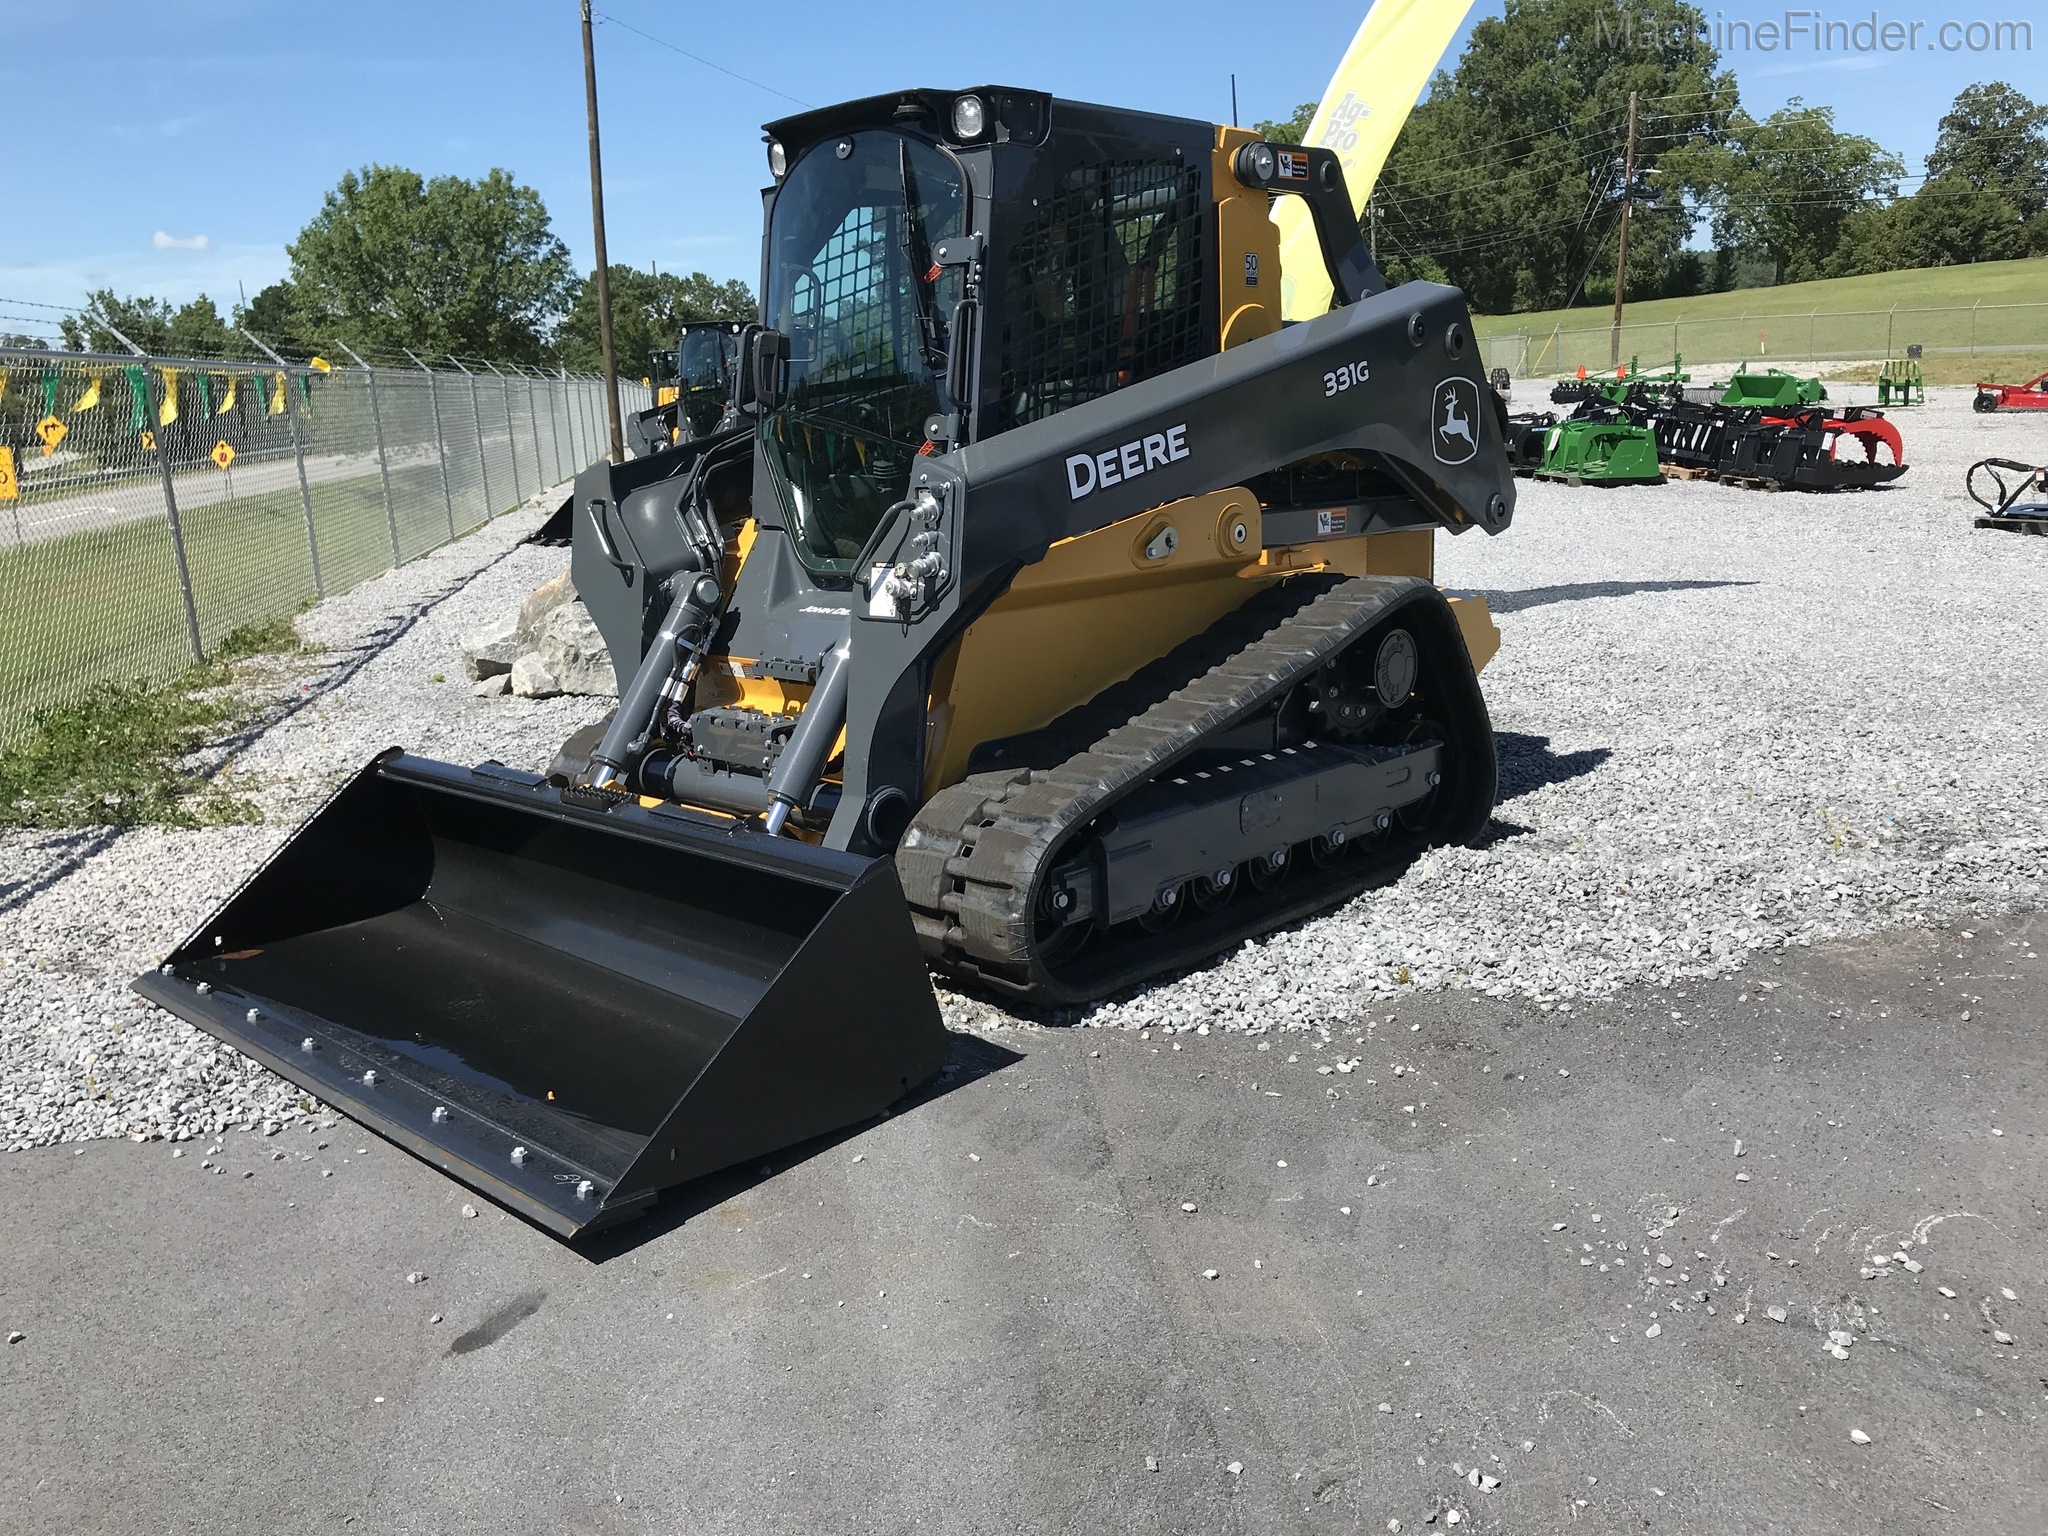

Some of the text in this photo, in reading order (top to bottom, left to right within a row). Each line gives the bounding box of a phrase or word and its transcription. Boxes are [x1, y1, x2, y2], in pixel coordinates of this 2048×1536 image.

[1330, 91, 1371, 128] Ag-
[1319, 118, 1358, 151] Pro
[1245, 254, 1257, 270] 50
[1323, 360, 1370, 397] 331G
[1065, 423, 1190, 500] DEERE
[799, 605, 835, 614] JOHN
